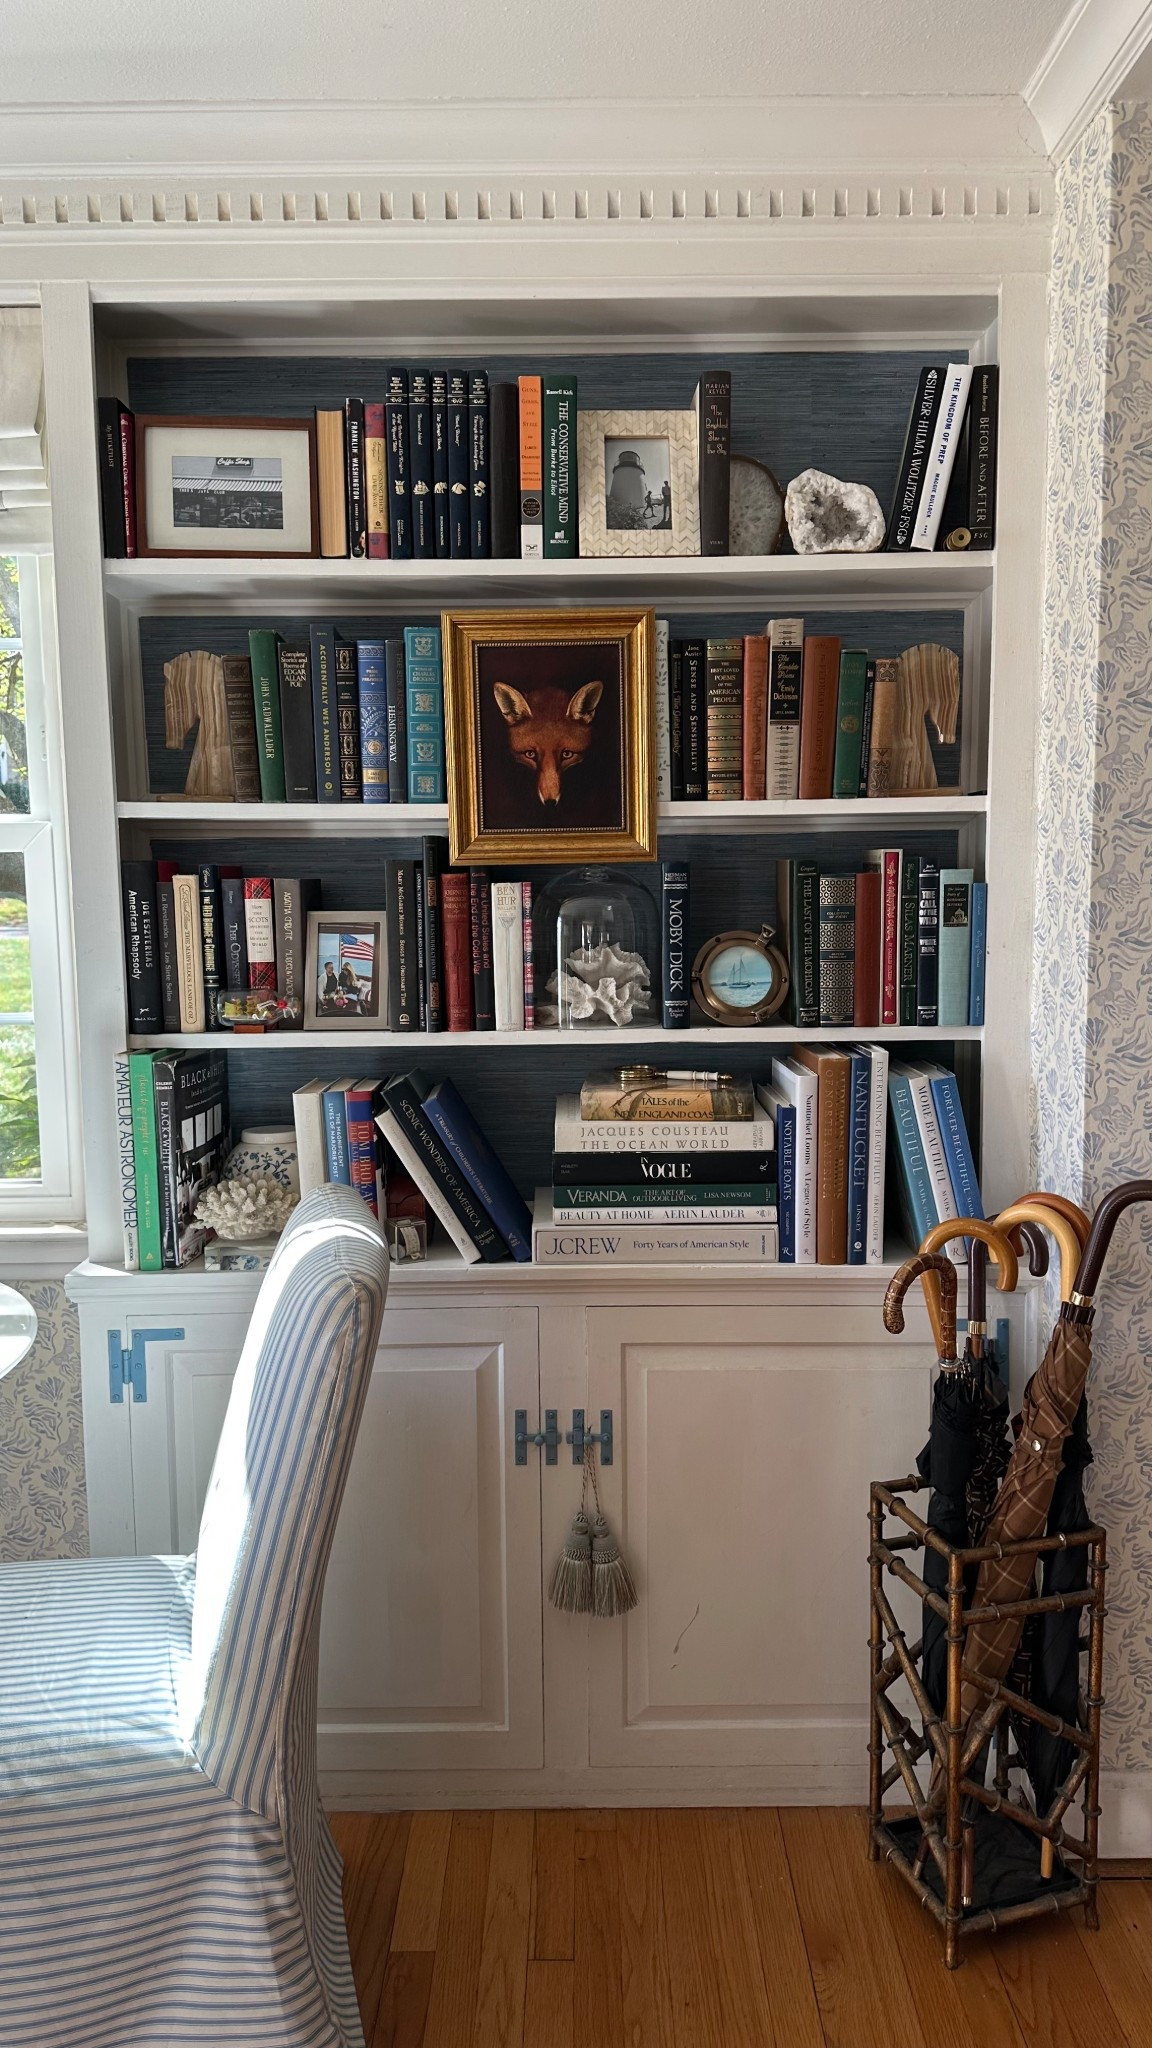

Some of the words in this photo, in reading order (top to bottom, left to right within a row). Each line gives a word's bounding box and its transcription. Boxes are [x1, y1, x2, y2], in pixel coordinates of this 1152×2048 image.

[920, 378, 936, 416] SILVER
[953, 377, 962, 392] THE
[559, 401, 568, 420] THE
[945, 394, 958, 430] KINGDOM
[913, 420, 928, 456] HILMA
[938, 444, 948, 464] PREP
[942, 432, 950, 442] OF
[978, 417, 990, 460] BEFORE
[559, 424, 568, 494] CONSERVATIVE
[903, 458, 922, 512] WOLITZER
[559, 496, 568, 523] MIND
[976, 484, 987, 523] AFTER
[897, 515, 911, 536] FSG
[260, 677, 270, 697] JOHN
[319, 645, 328, 704] ACCIDENTALLY
[689, 660, 698, 689] SENSE
[781, 685, 795, 694] Emily
[262, 701, 274, 759] CADWALLADER
[388, 706, 397, 762] HEMINGWAY
[752, 670, 762, 765] HAWTHORNE
[323, 729, 331, 774] ANDERSON
[689, 715, 698, 772] SENSIBILITY
[284, 892, 292, 914] AGATHA
[497, 886, 515, 895] BEN
[497, 897, 516, 906] HUR
[803, 878, 812, 897] THE
[128, 890, 140, 932] American
[141, 901, 149, 915] JOE
[669, 899, 683, 947] MOBY
[904, 902, 914, 931] SILAS
[919, 917, 937, 925] WILD
[143, 919, 152, 968] ESZTERHAS
[229, 923, 238, 941] THE
[804, 922, 812, 934] OF
[131, 935, 141, 979] Rhapsody
[231, 943, 241, 985] ODYSSEY
[669, 951, 683, 992] DICK
[904, 935, 914, 981] MARNER
[805, 957, 813, 1004] MOHICANS
[115, 1061, 133, 1121] AMATEUR
[825, 1069, 834, 1085] OF
[874, 1061, 884, 1127] ENTERTAINING
[160, 1101, 169, 1135] BLACK
[642, 1098, 667, 1106] TALES
[677, 1098, 689, 1106] the
[804, 1094, 814, 1136] Nantucket
[824, 1090, 833, 1136] NORTH
[834, 1070, 845, 1151] AUDUBON'S
[357, 1123, 370, 1151] TOM
[581, 1127, 644, 1137] JACQUES
[652, 1127, 728, 1136] COUSTEAU
[581, 1141, 609, 1149] THE
[617, 1140, 668, 1149] OCEAN
[676, 1140, 729, 1149] WORLD
[783, 1120, 792, 1166] NOTABLE
[853, 1070, 868, 1189] NANTUCKET
[162, 1140, 171, 1171] WHITE
[399, 1099, 423, 1130] SCENIC
[418, 1130, 448, 1174] WONDERS
[445, 1174, 456, 1186] OF
[452, 1188, 481, 1227] AMERICA
[804, 1138, 813, 1165] Looms
[873, 1129, 882, 1186] BEAUTIFULLY
[918, 1085, 931, 1120] MORE
[926, 1121, 946, 1185] BEAUTIFUL
[941, 1190, 950, 1212] MARK
[942, 1084, 957, 1132] FOREVER
[953, 1135, 971, 1194] BEAUTIFUL
[967, 1197, 975, 1218] MARK
[120, 1130, 138, 1229] ASTRONOMER
[641, 1163, 691, 1178] VOGUE
[783, 1169, 792, 1200] BOATS
[822, 1141, 833, 1199] AMERICA
[834, 1159, 843, 1199] BIRDS
[566, 1189, 627, 1204] VERANDA
[803, 1178, 812, 1206] Legacy
[559, 1211, 601, 1221] BEAUTY
[604, 1211, 619, 1220] AT
[621, 1210, 654, 1219] HOME
[662, 1210, 698, 1219] AERIN
[701, 1209, 746, 1219] LAUDER
[803, 1218, 812, 1238] Style
[804, 1208, 812, 1217] of
[545, 1237, 621, 1255] J.CREW
[633, 1241, 655, 1250] Forty
[656, 1240, 678, 1248] Years
[680, 1240, 689, 1248] of
[690, 1239, 728, 1248] American
[729, 1239, 750, 1249] Style
